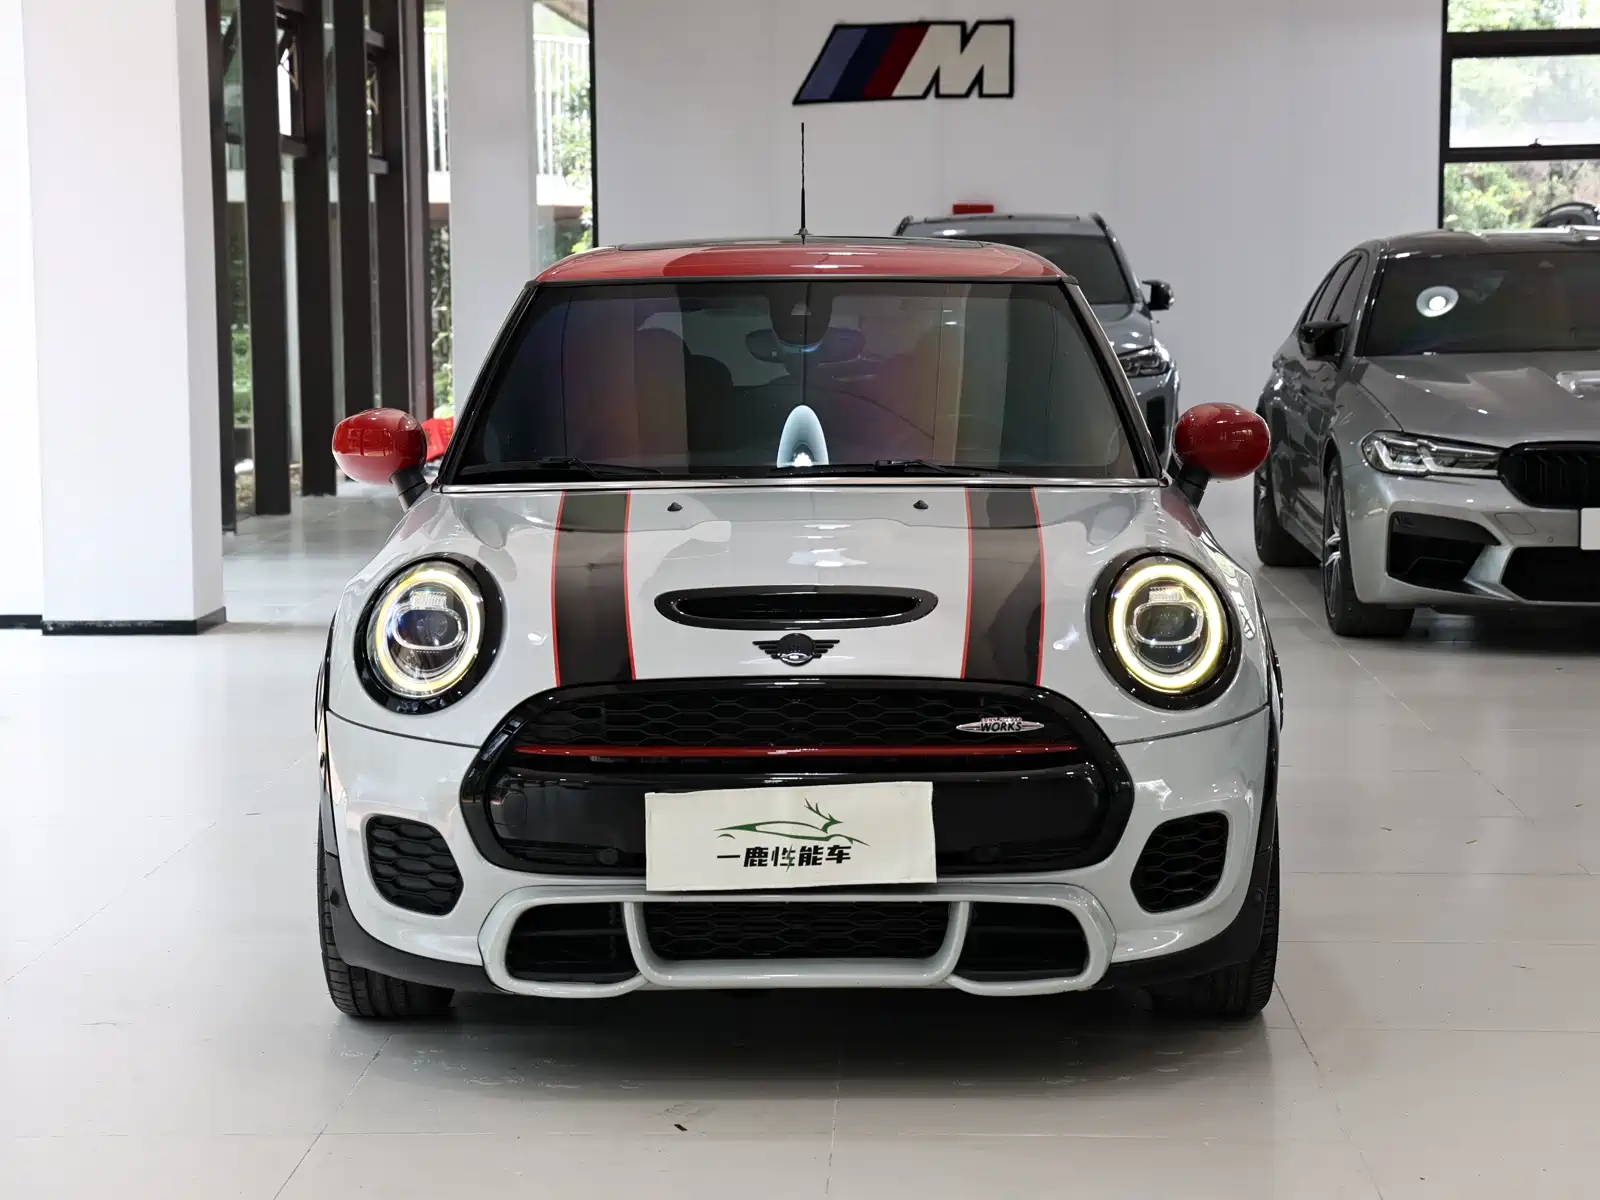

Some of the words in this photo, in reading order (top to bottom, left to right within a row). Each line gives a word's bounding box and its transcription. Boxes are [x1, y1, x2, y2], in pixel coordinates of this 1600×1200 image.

[888, 20, 1014, 100] M
[981, 722, 1022, 732] WORKS
[717, 845, 851, 869] 一鹿性能车
